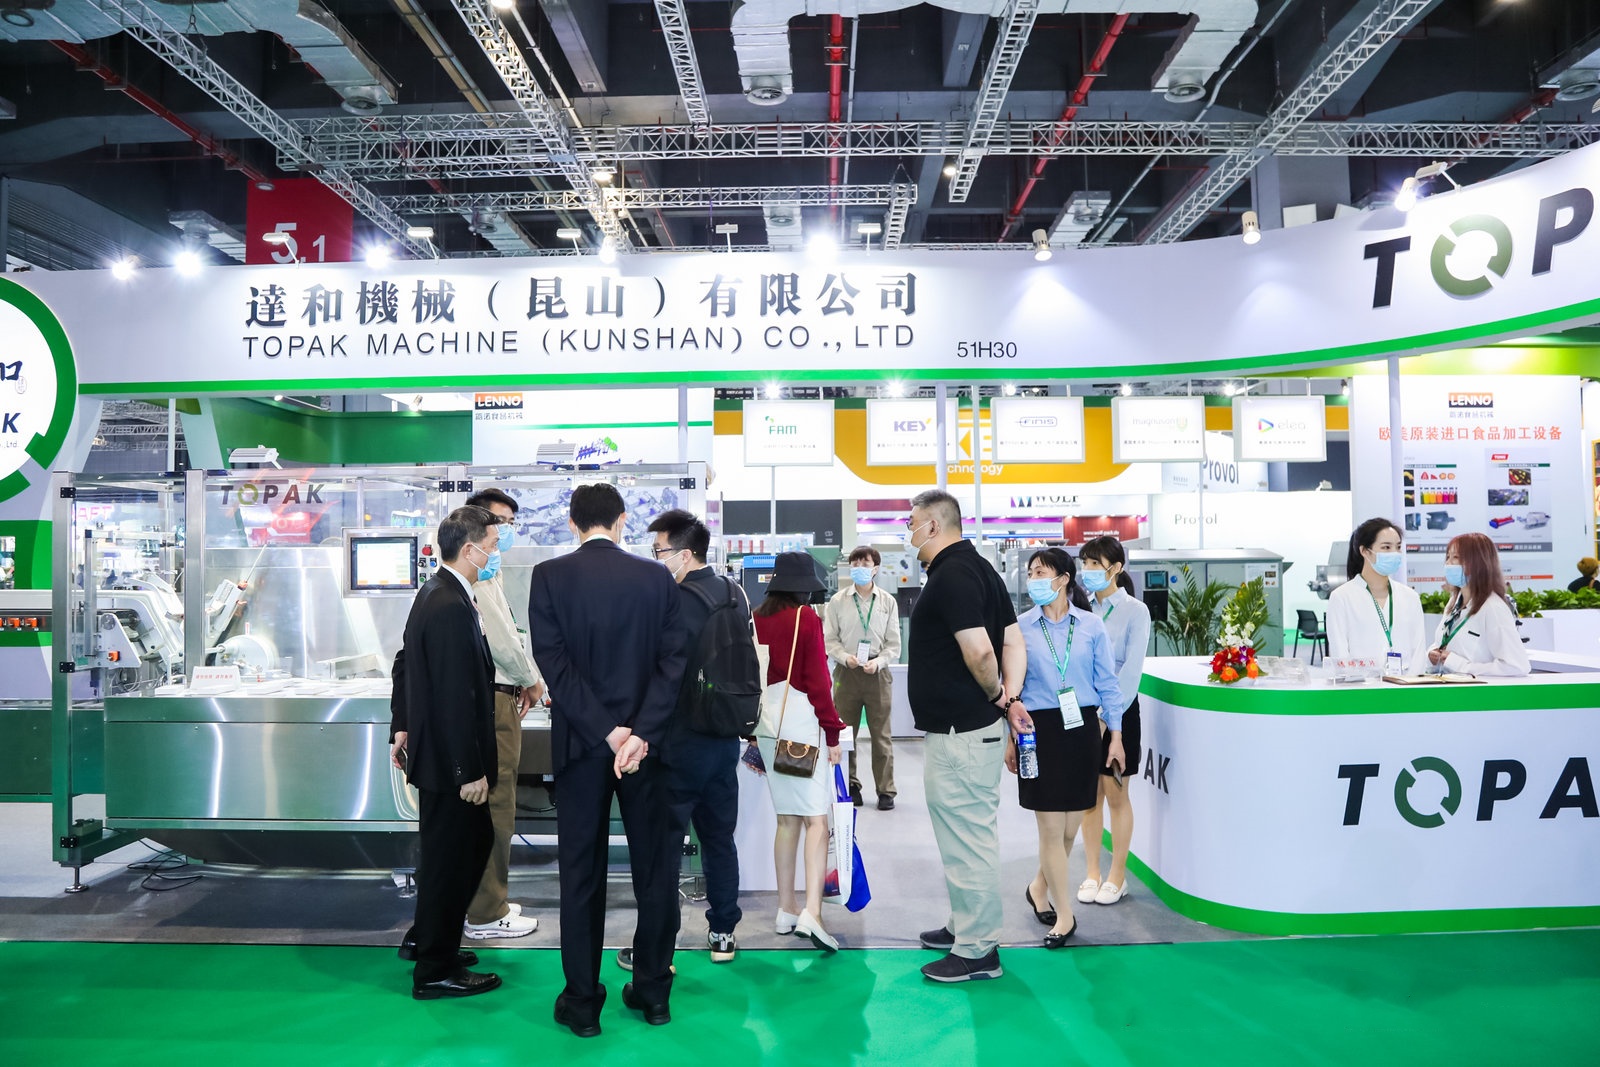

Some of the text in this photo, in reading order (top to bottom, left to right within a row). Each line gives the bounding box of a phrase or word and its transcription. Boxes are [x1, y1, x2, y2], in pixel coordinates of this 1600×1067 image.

[270, 222, 325, 264] 5.1
[242, 334, 348, 358] TOPAK
[367, 330, 518, 355] MACHINE
[542, 326, 742, 353] (KUNSHAN)
[957, 341, 1017, 358] 51H30
[477, 395, 521, 407] LENNO
[1450, 394, 1492, 406] LENNO
[769, 425, 797, 434] FAM
[893, 418, 932, 432] KEY
[1378, 426, 1562, 441] 欧美原装进口食品加工设备
[937, 464, 1003, 475] chnoogy
[220, 483, 325, 505] TOPAK
[1139, 747, 1171, 794] AK
